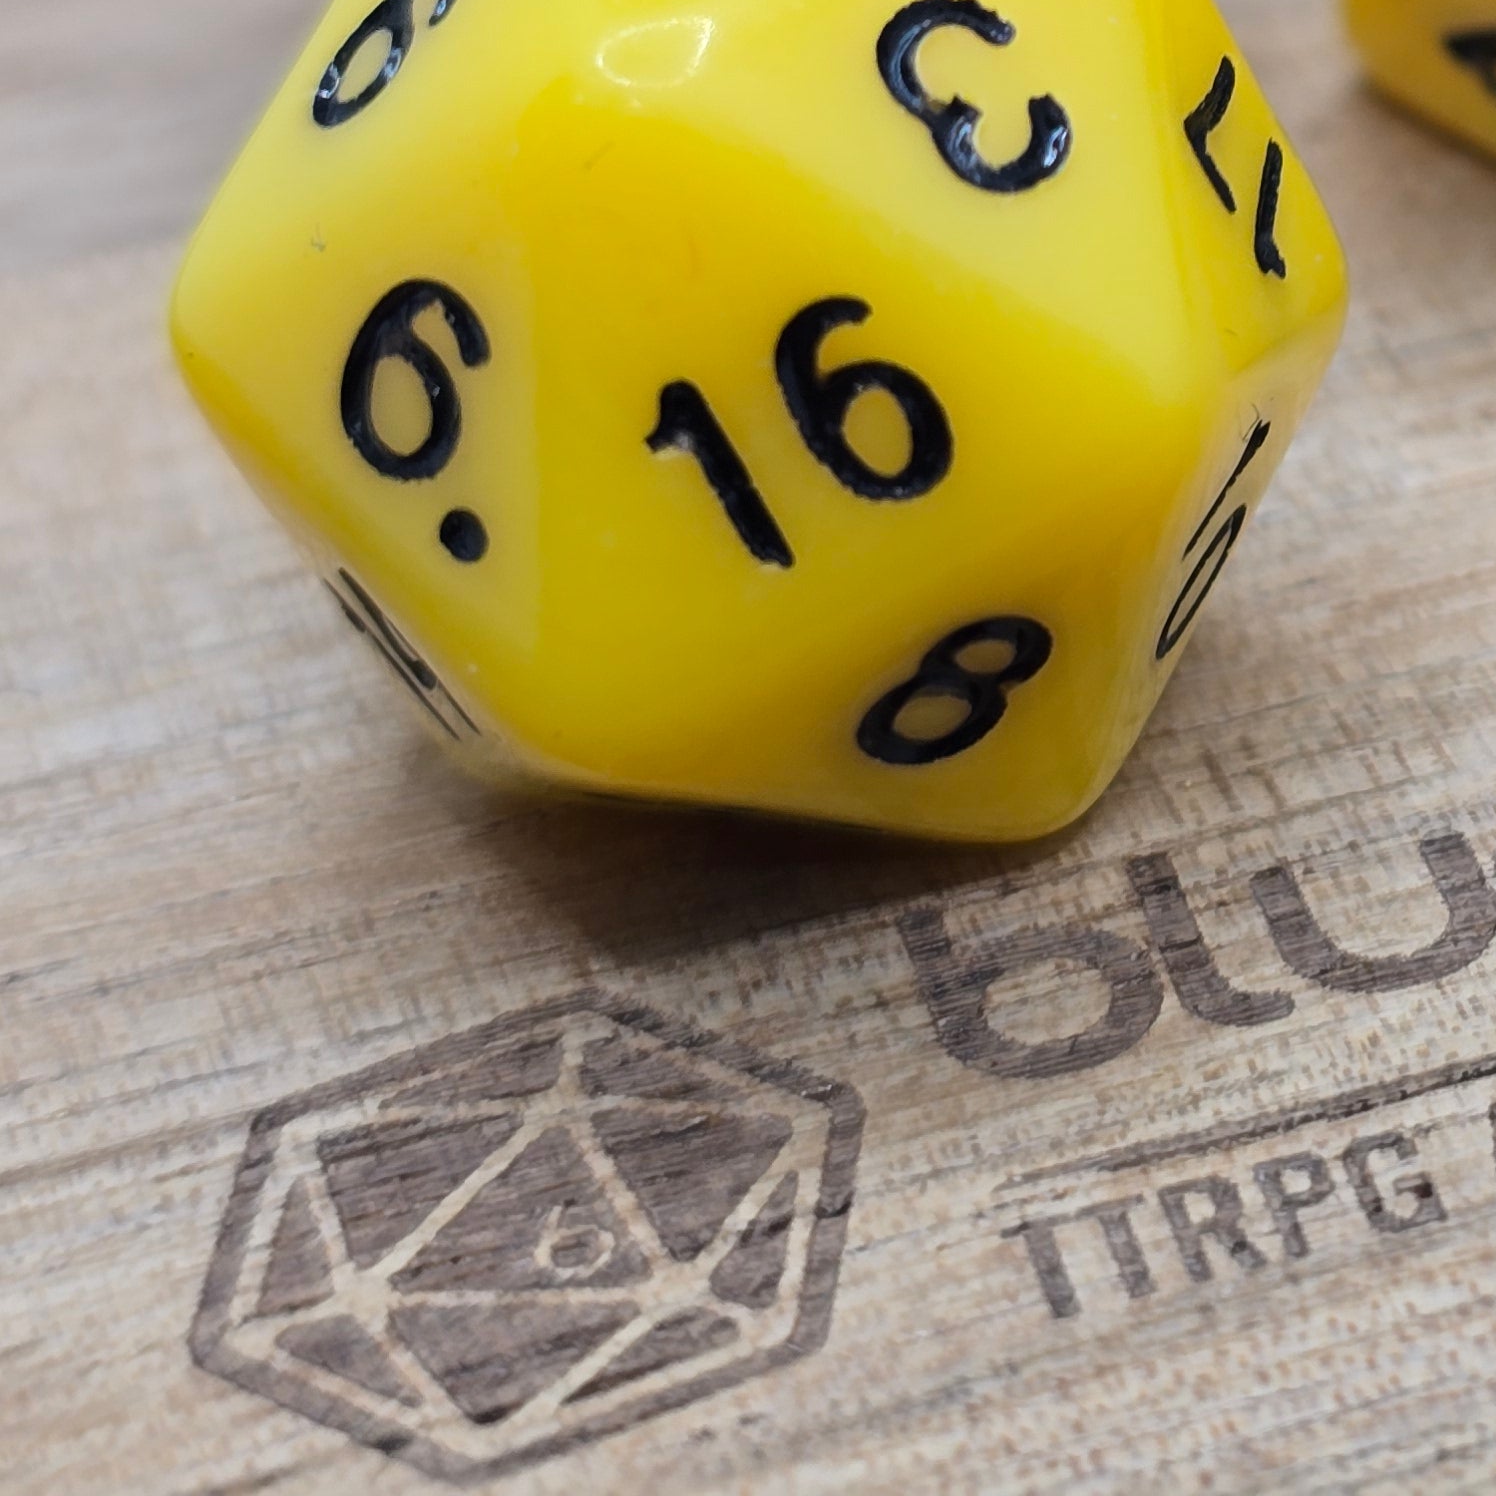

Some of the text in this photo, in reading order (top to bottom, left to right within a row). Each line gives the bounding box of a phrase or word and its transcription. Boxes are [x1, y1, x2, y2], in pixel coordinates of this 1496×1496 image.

[644, 295, 955, 570] 16
[854, 614, 1054, 767] 8
[1002, 1126, 1447, 1319] TTRPG
